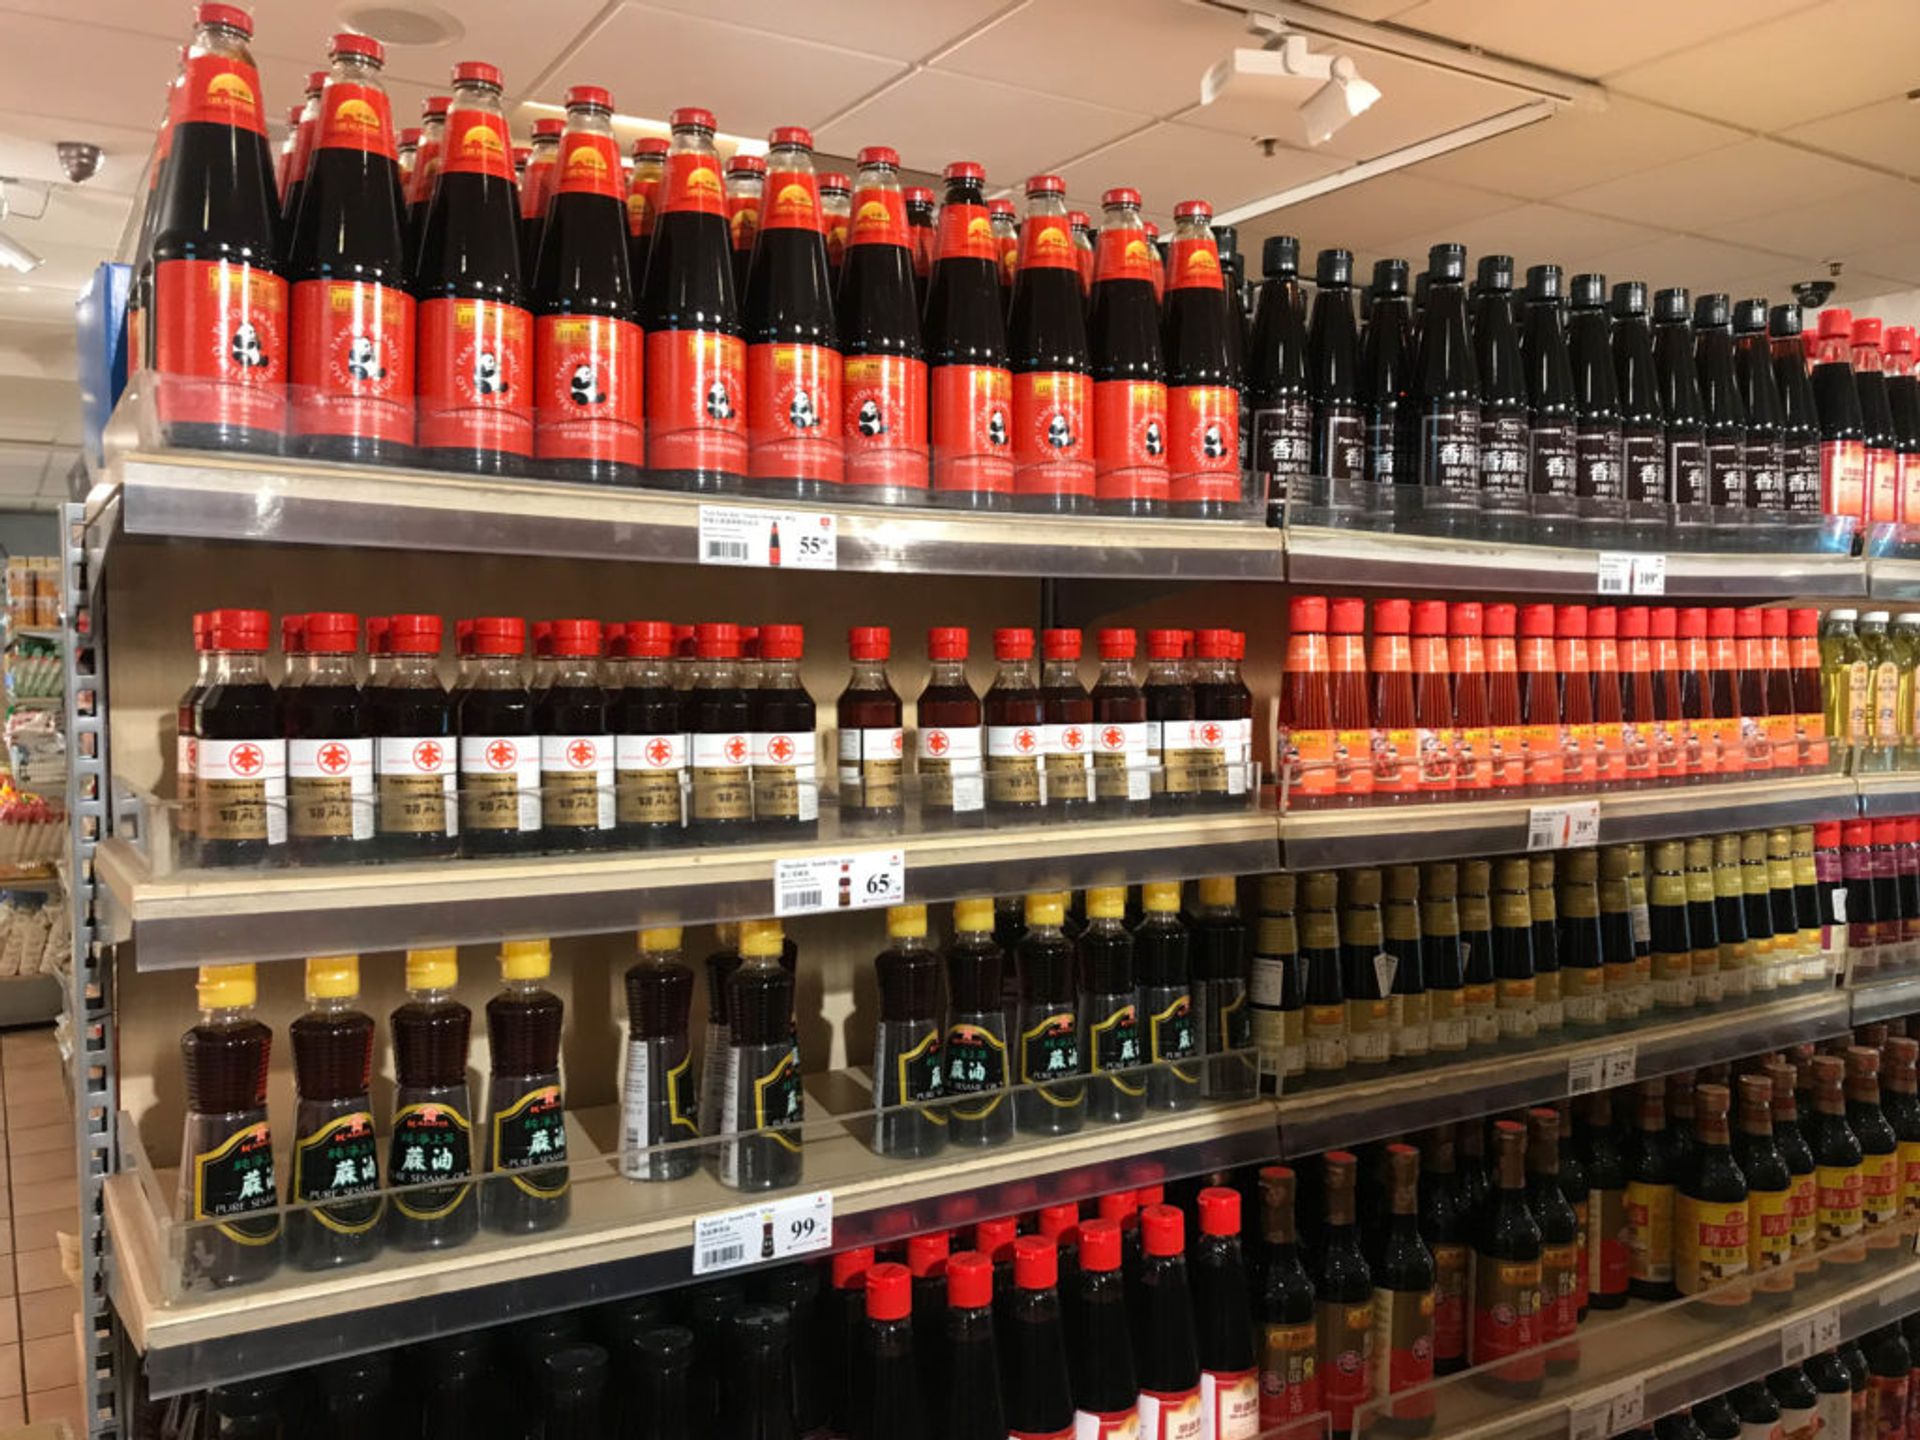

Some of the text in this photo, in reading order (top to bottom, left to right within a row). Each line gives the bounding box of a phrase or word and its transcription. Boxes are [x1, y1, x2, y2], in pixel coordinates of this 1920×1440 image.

[800, 536, 821, 554] 55
[866, 873, 889, 894] 65
[215, 1202, 244, 1215] PURE
[791, 1217, 815, 1239] 99
